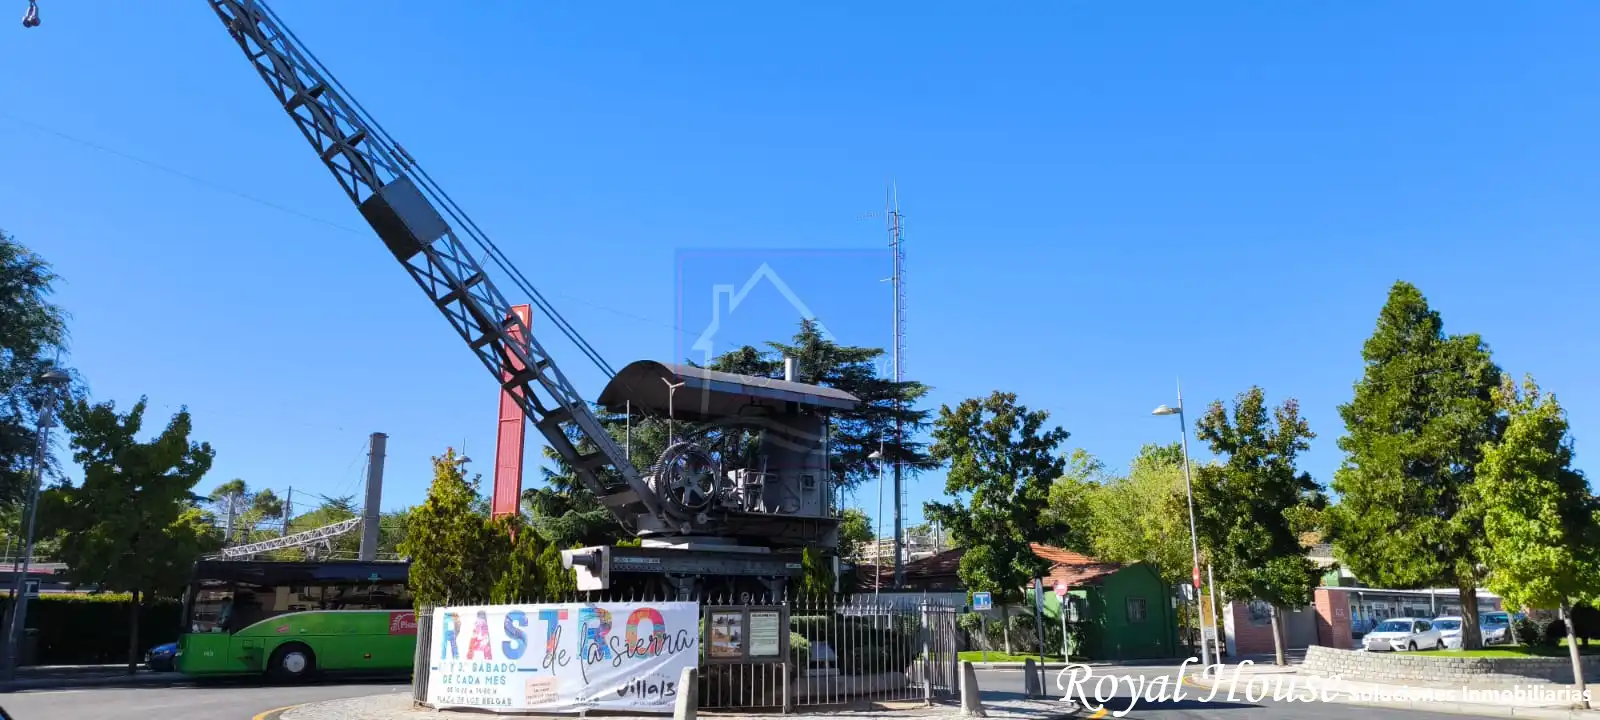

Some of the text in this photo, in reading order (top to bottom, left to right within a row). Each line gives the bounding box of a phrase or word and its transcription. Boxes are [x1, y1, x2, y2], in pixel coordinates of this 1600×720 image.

[441, 607, 666, 660] RASTRO
[542, 624, 571, 676] de
[579, 622, 606, 685] la
[609, 629, 697, 668] sierra
[442, 674, 507, 686] DE CADA MES
